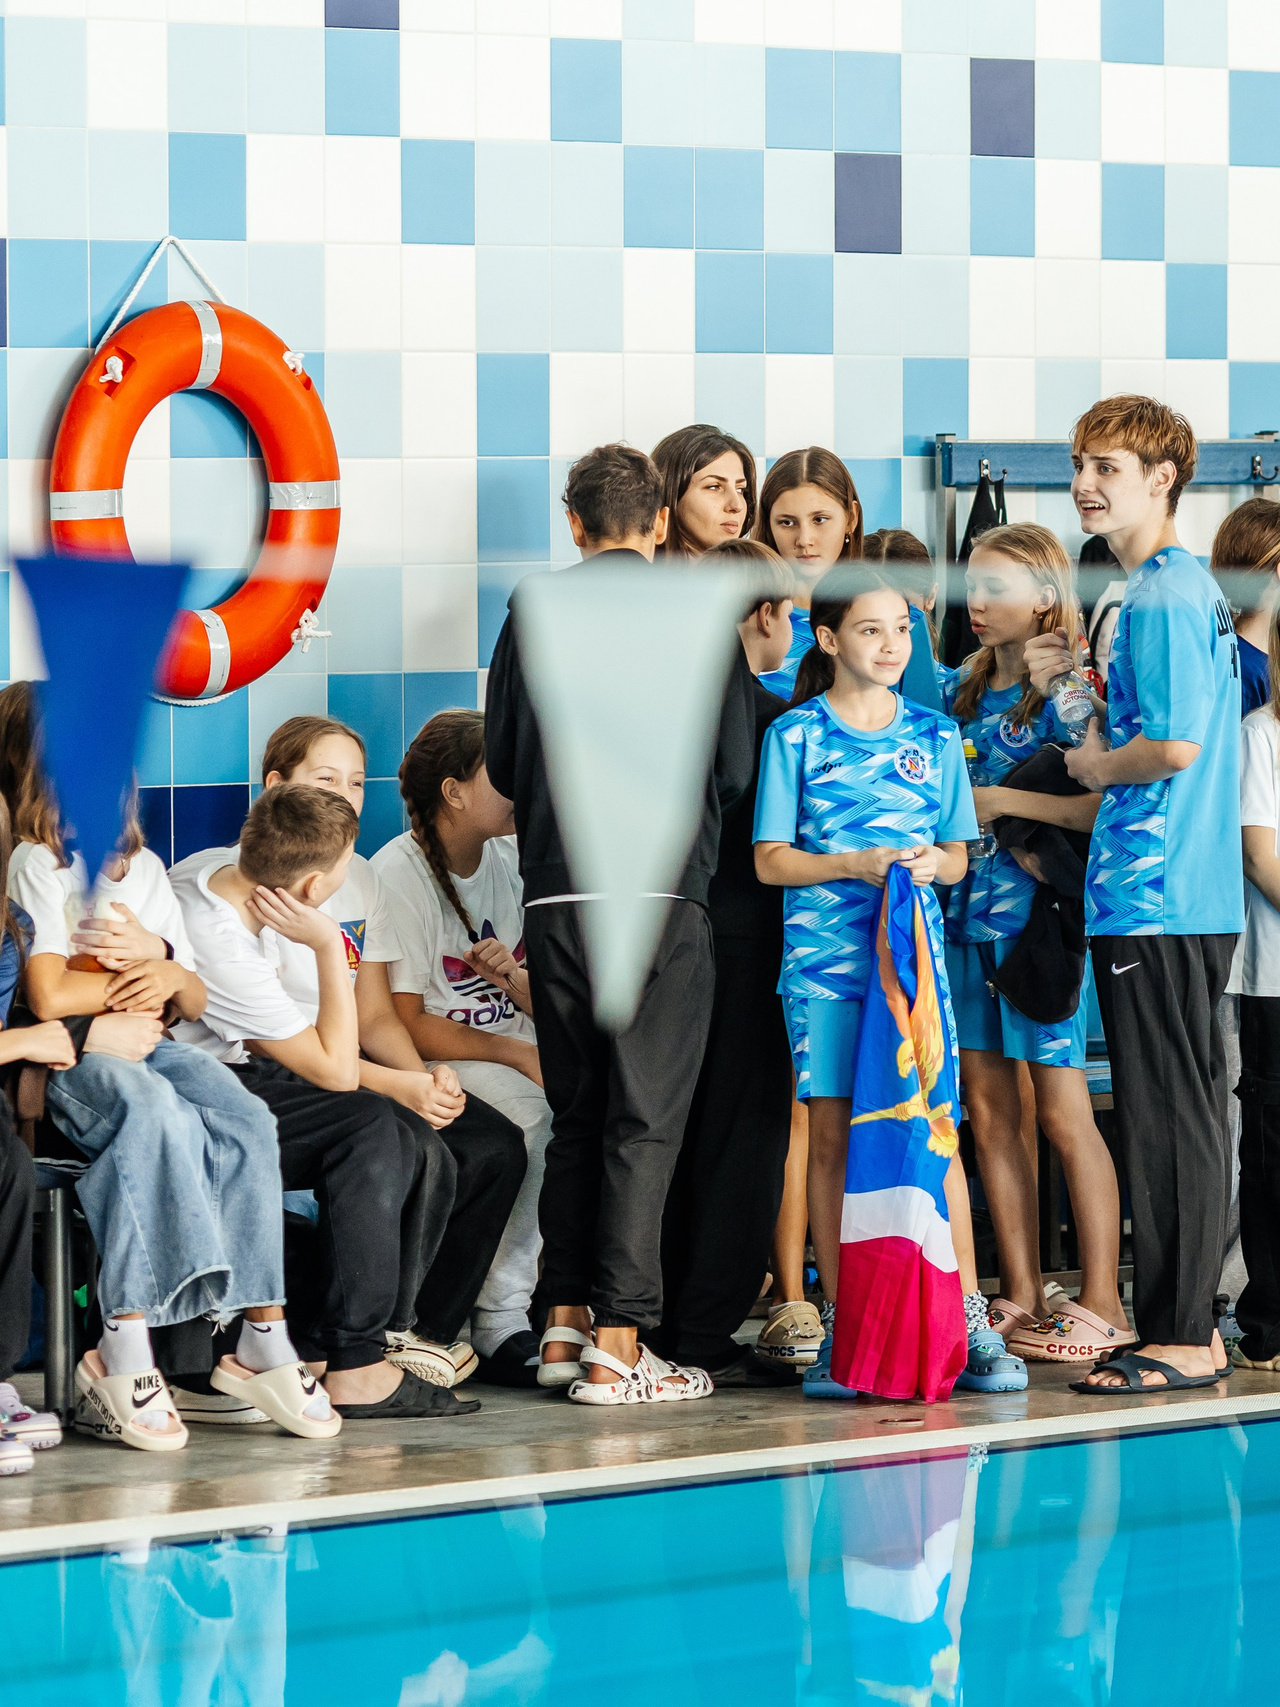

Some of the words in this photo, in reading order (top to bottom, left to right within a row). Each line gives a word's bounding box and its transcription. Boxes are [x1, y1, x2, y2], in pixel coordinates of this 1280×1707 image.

[1061, 694, 1090, 706] ИСТОЧНИ
[1046, 1343, 1093, 1355] crocs
[133, 1375, 160, 1392] NIKE
[86, 1386, 103, 1406] JUST
[100, 1404, 109, 1420] DO
[107, 1415, 116, 1426] IT
